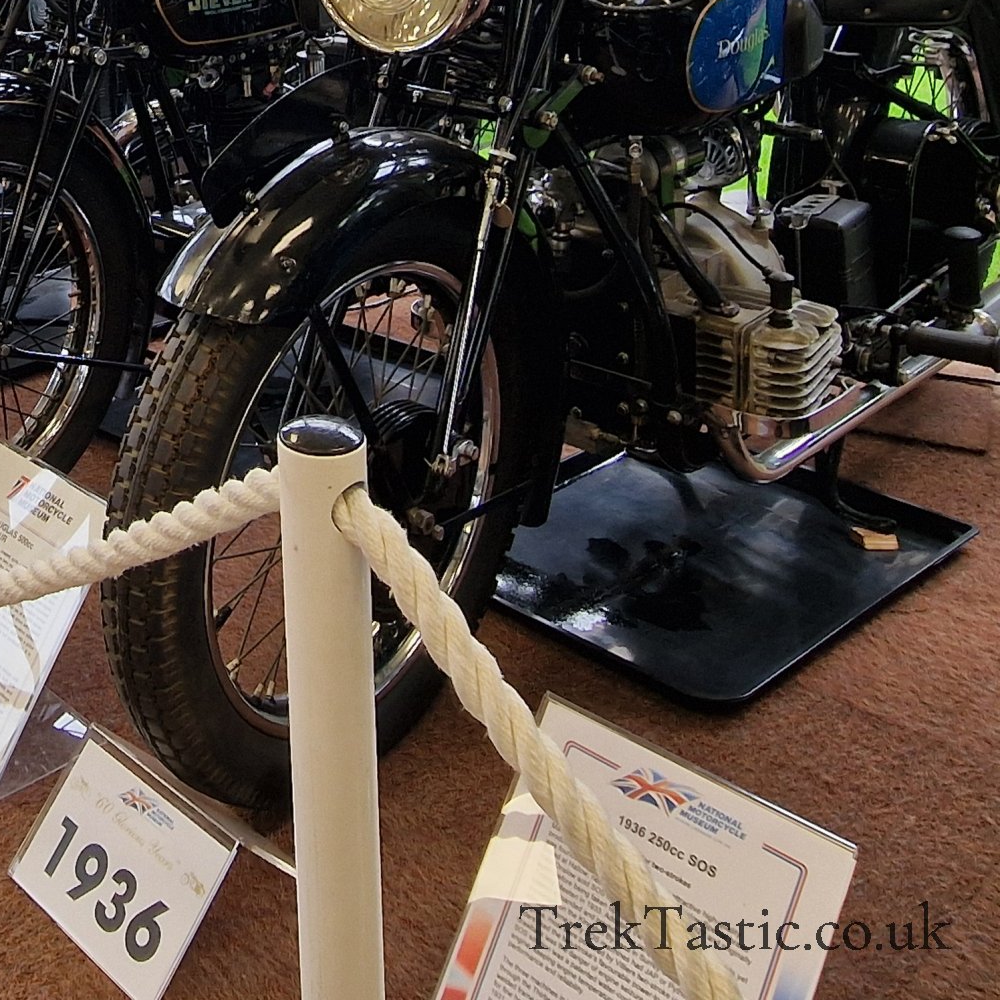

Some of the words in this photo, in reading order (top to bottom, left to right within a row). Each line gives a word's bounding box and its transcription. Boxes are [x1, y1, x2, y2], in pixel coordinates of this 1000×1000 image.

[716, 28, 770, 59] Douglas
[679, 809, 719, 835] MUSEUM
[688, 805, 747, 841] MOTORCYCLE
[698, 801, 743, 830] NATIONAL
[618, 815, 646, 838] 1936
[647, 832, 685, 860] 250cc
[688, 854, 718, 878] SOS
[44, 816, 170, 962] 1936
[651, 862, 692, 889] two-strokes
